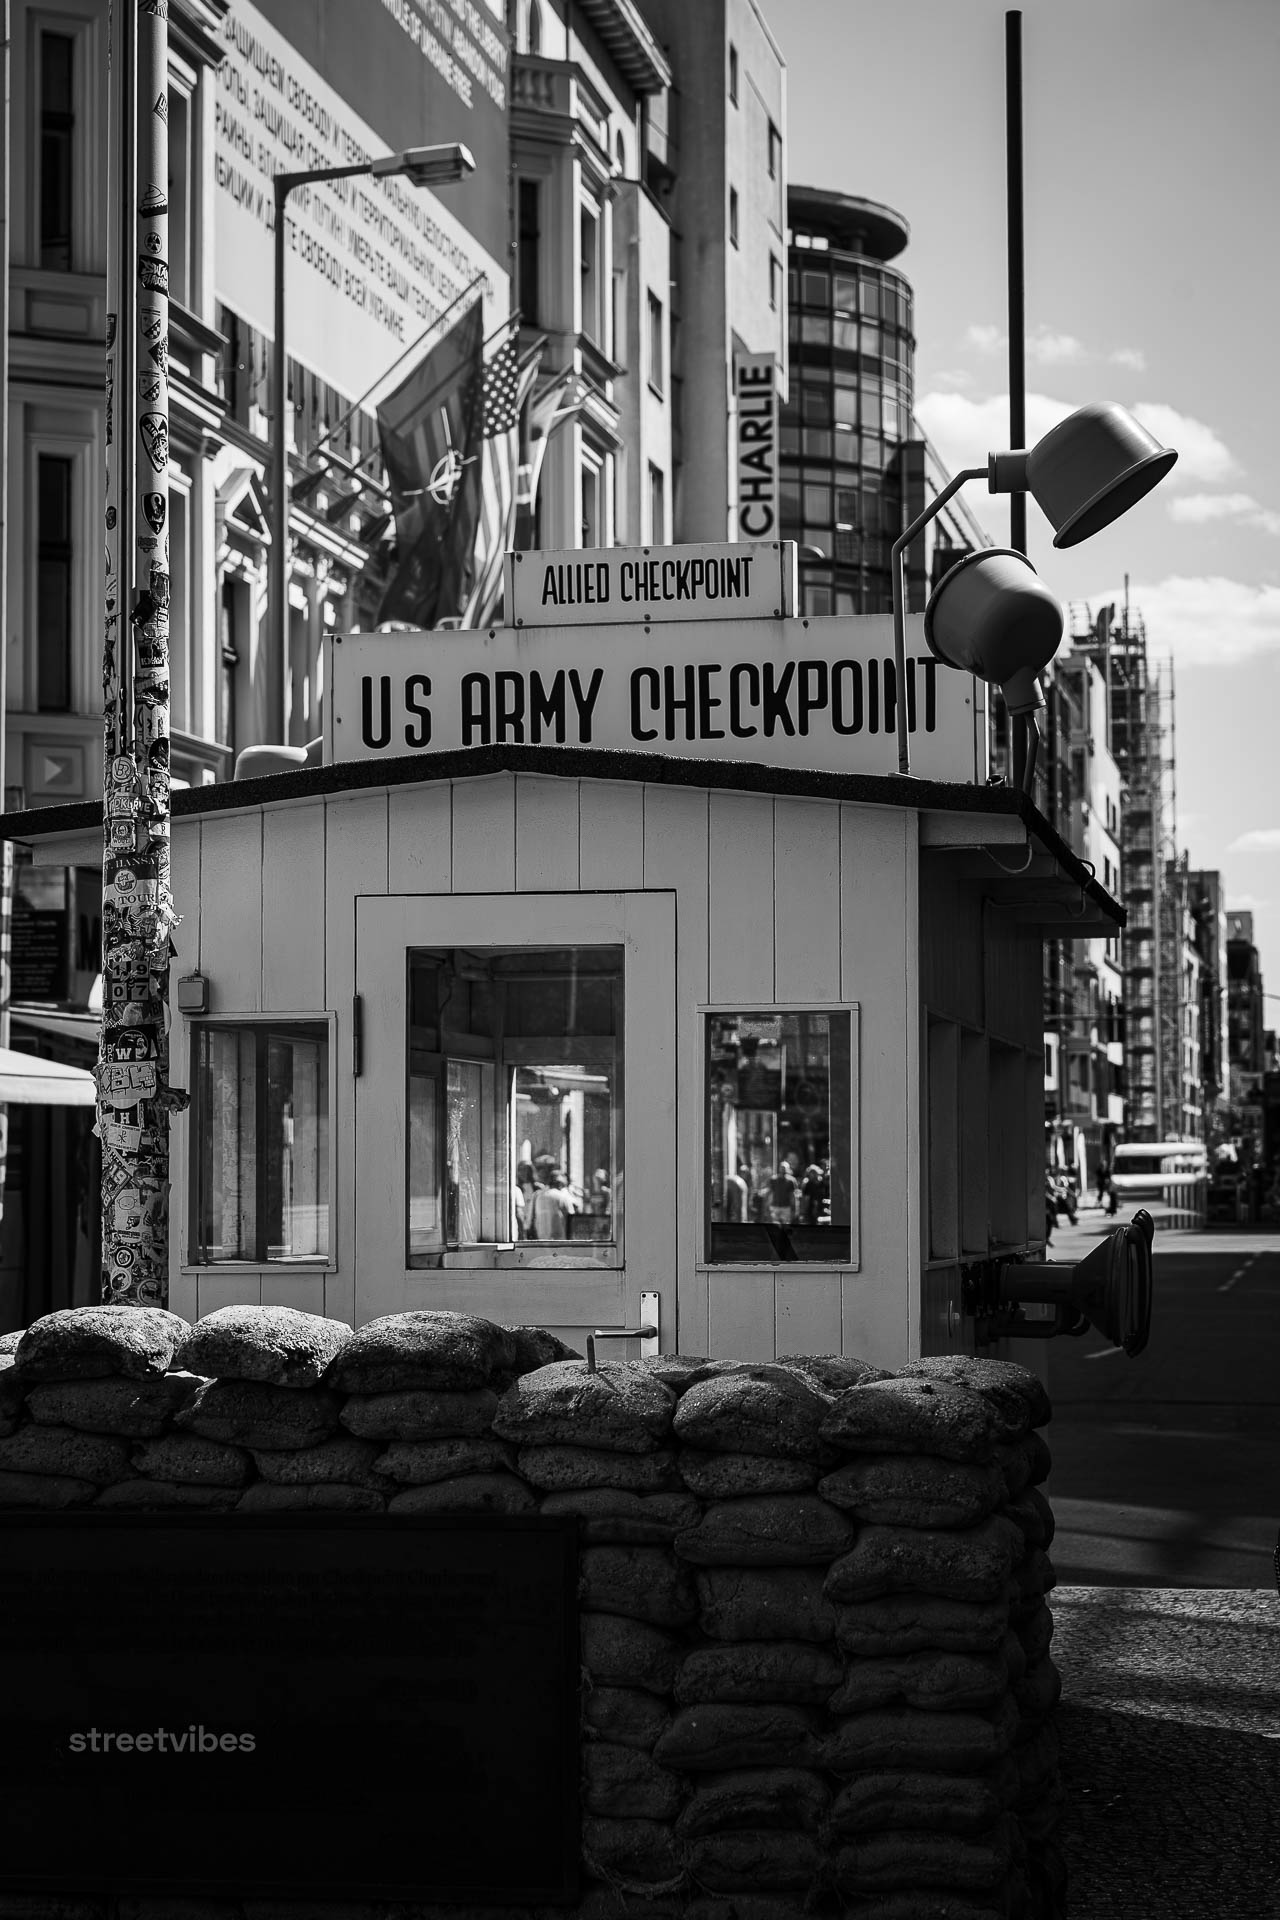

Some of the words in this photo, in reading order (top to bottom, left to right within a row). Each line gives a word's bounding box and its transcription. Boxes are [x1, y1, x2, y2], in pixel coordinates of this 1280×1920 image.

[739, 366, 774, 537] CHARLIE
[542, 564, 610, 605] ALLIED
[620, 557, 754, 603] CHECKPOINT
[461, 668, 604, 745] ARMY
[630, 656, 943, 742] CHECKPOINT
